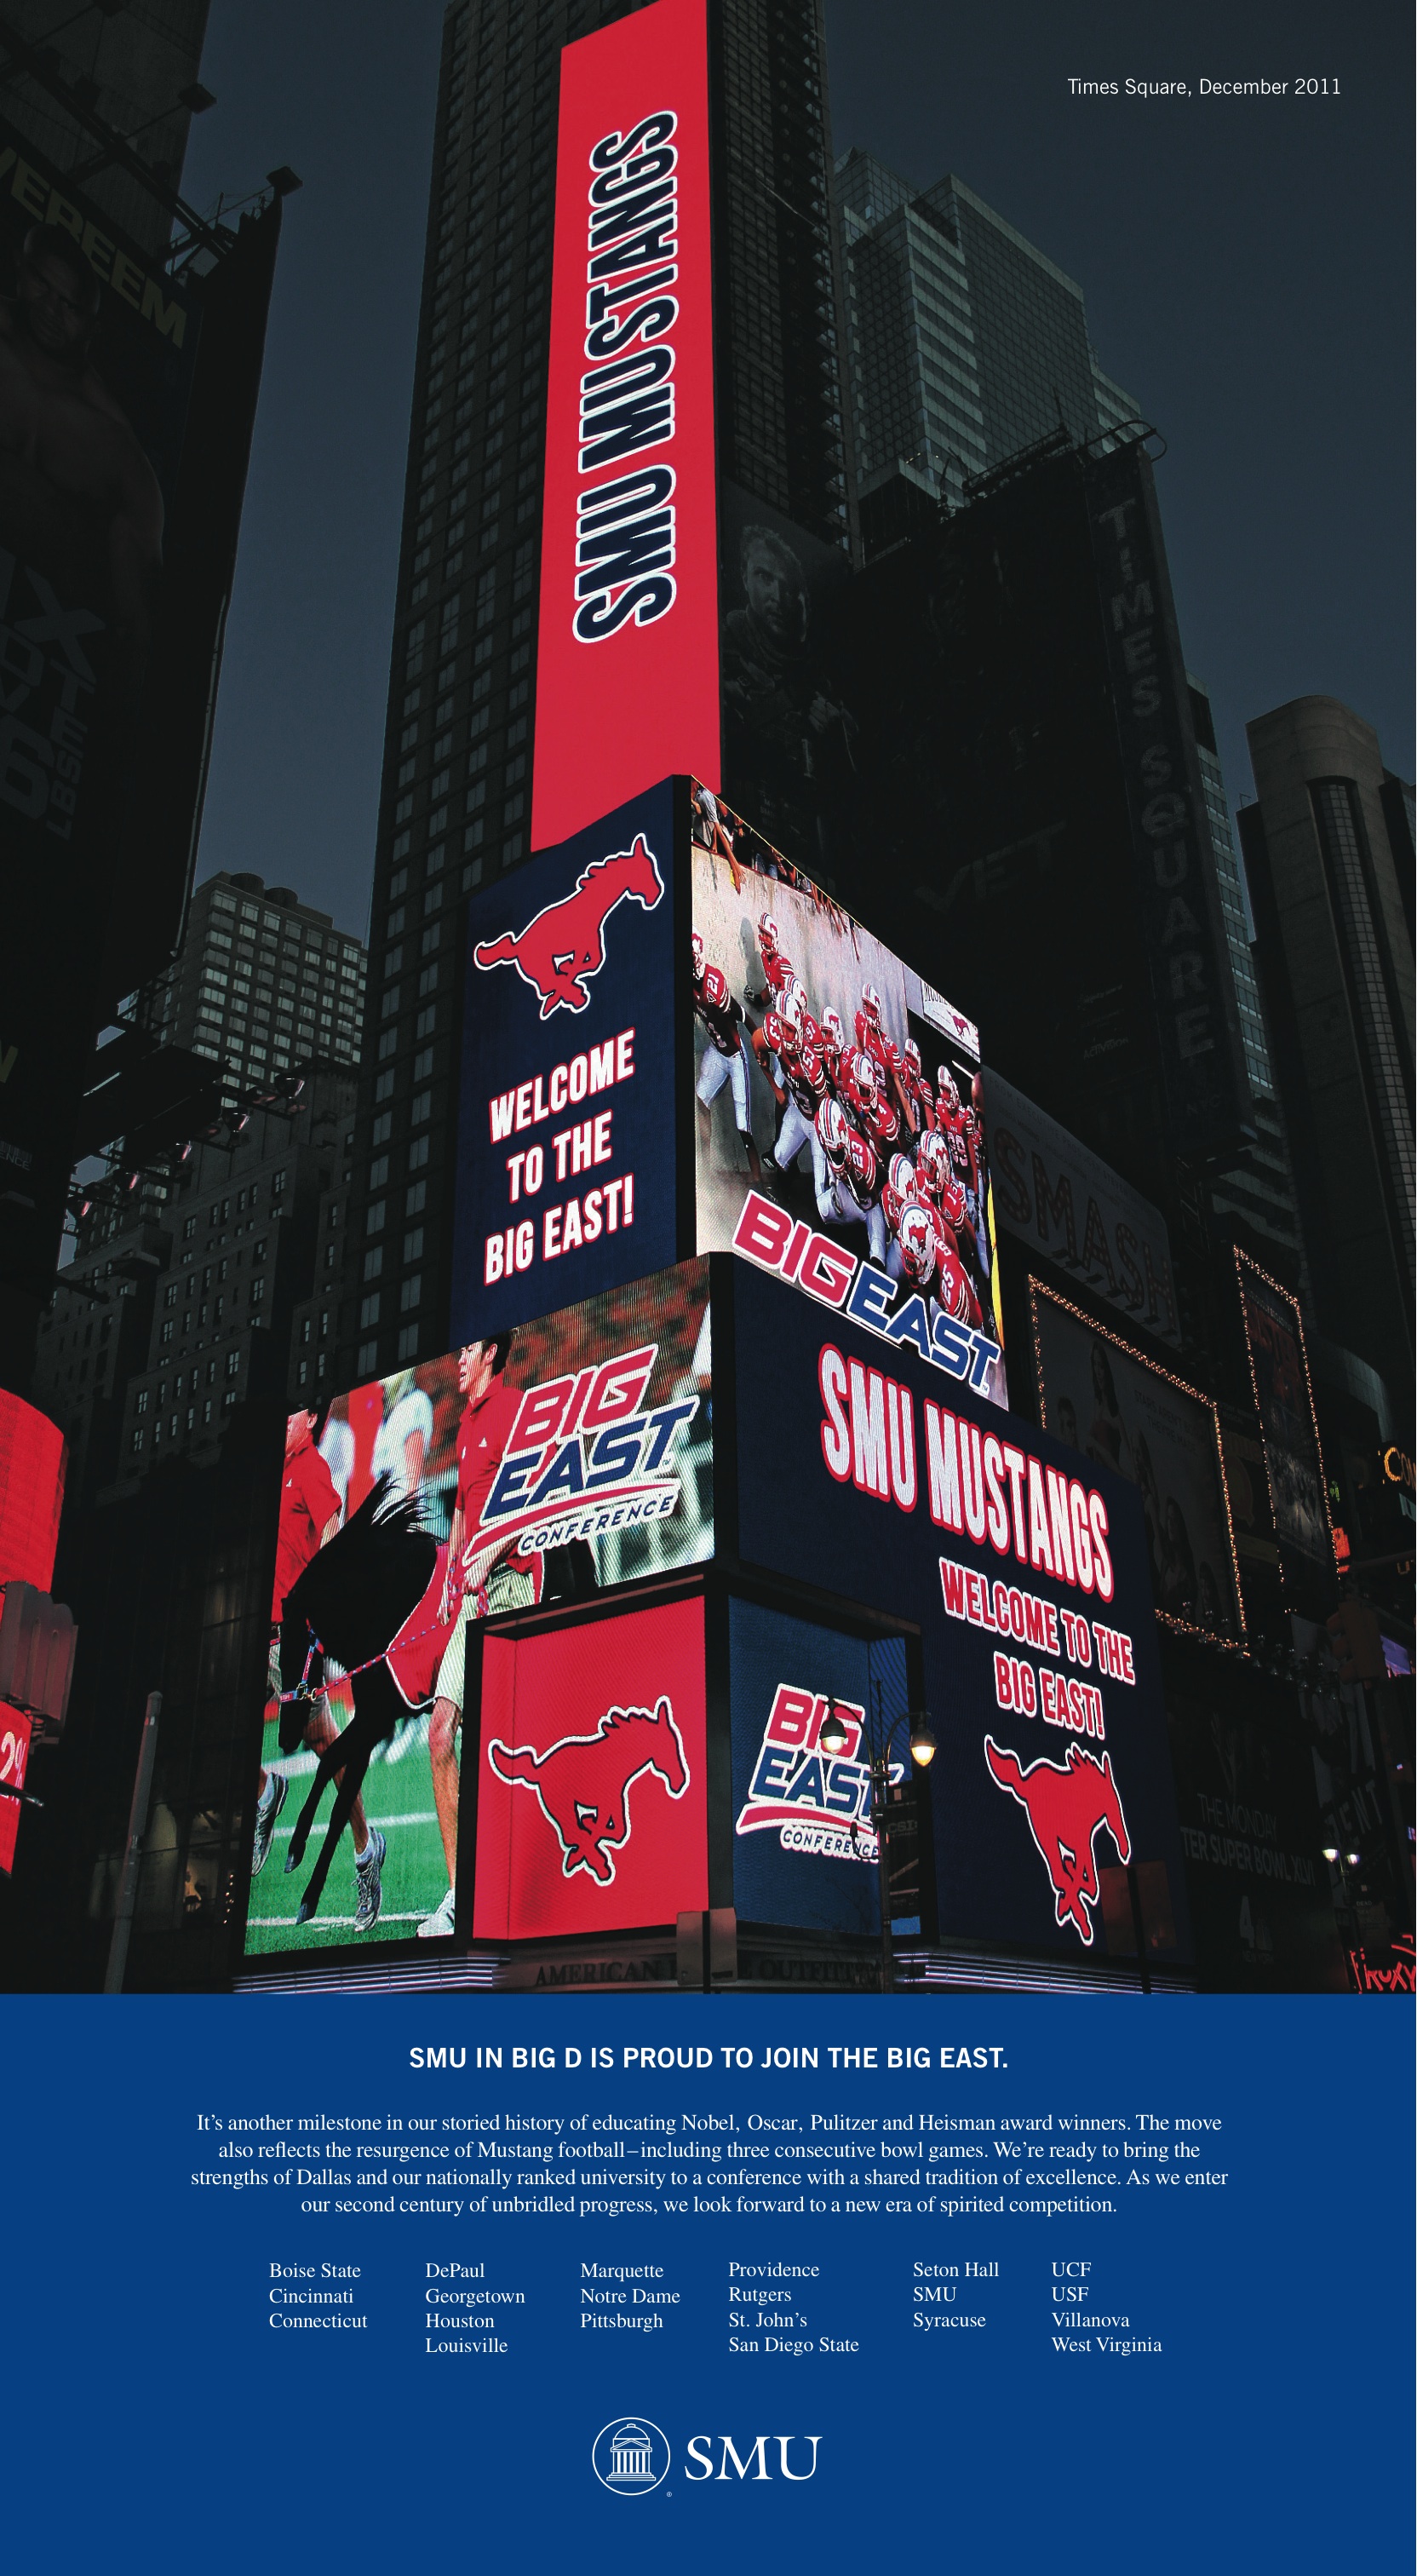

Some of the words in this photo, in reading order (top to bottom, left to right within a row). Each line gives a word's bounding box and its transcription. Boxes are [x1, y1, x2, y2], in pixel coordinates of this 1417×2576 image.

[578, 110, 680, 474] MUSTANGS
[572, 463, 677, 644] SMU
[1097, 497, 1162, 717] TIMES
[1141, 743, 1215, 1059] SQUARE
[707, 974, 720, 995] 21
[489, 1026, 635, 1144] WELCOME
[1083, 1037, 1129, 1061] ACTIVISION
[507, 1143, 544, 1204] TO
[552, 1109, 612, 1182] THE
[852, 1142, 863, 1170] 23
[484, 1218, 535, 1286] BIG
[542, 1172, 634, 1262] EAST!
[994, 1127, 1177, 1331] SMASH
[731, 1189, 858, 1308] BIG
[846, 1261, 1001, 1394] EAST
[504, 1343, 659, 1459] BIG
[479, 1394, 700, 1526] EAST
[818, 1343, 918, 1513] SMU
[924, 1397, 1115, 1602] MUSTANGS
[520, 1494, 675, 1552] CONFERENCE
[939, 1556, 1060, 1657] WELCOME
[1060, 1608, 1093, 1668] TO
[1092, 1623, 1136, 1686] THE
[764, 1683, 865, 1762] BIG
[994, 1651, 1036, 1718] BIG
[1039, 1666, 1106, 1741] EAST!
[781, 1827, 879, 1860] CONFERENCE
[1196, 1793, 1225, 1829] THE
[1225, 1801, 1278, 1843] MONDAY
[1209, 1835, 1254, 1872] SUPER
[1254, 1846, 1292, 1882] BOWL
[1290, 1855, 1317, 1887] XLVI
[536, 1960, 662, 1986] AMERICAN
